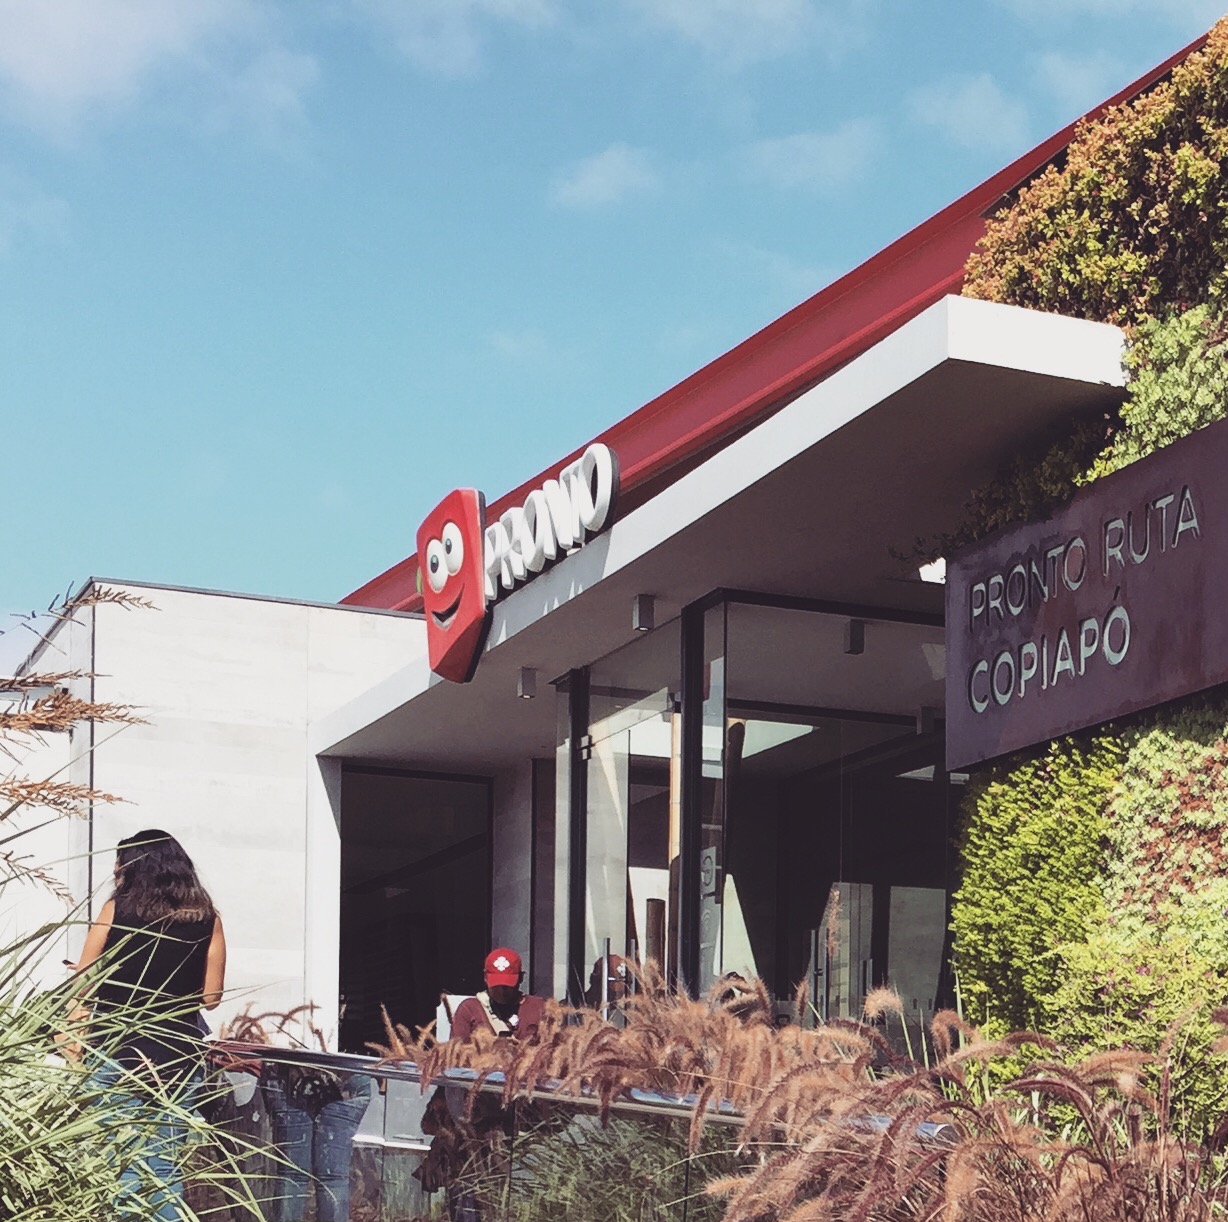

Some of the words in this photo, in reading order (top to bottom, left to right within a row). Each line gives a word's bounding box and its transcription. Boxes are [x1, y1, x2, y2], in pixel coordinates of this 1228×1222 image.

[970, 536, 1087, 633] PRONTO
[1103, 485, 1201, 578] RUTA
[968, 586, 1131, 714] COPIAPÓ
